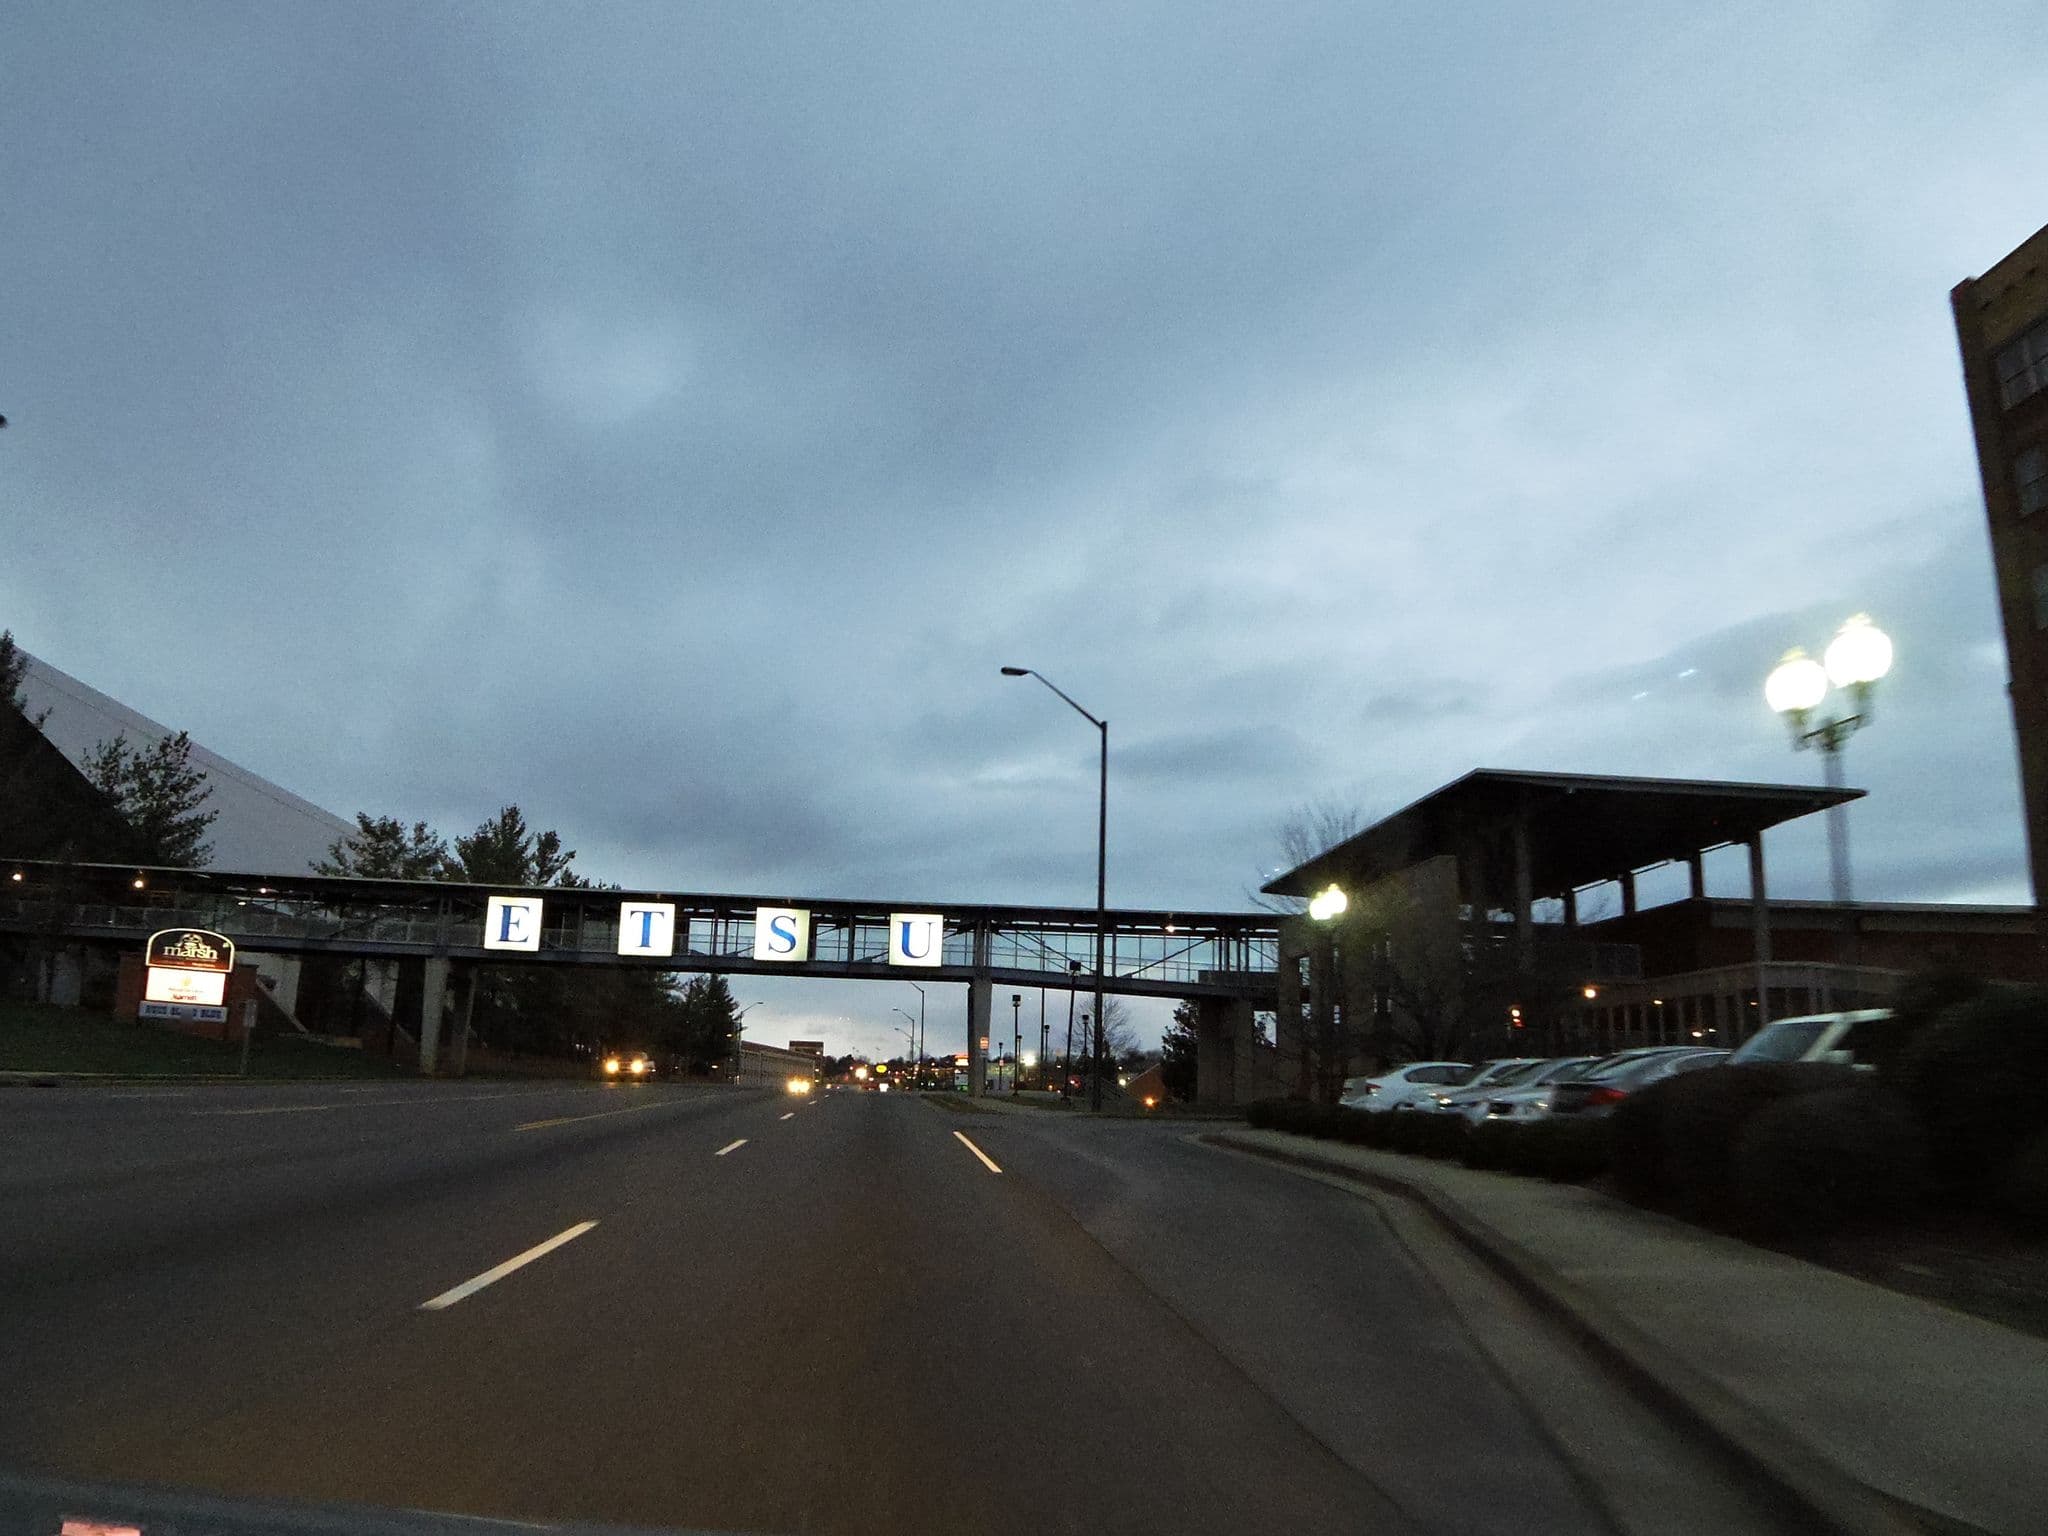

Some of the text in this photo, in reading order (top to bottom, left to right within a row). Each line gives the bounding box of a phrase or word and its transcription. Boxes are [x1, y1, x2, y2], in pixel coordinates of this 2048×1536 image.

[496, 904, 932, 958] E T S U
[163, 943, 218, 959] marsh
